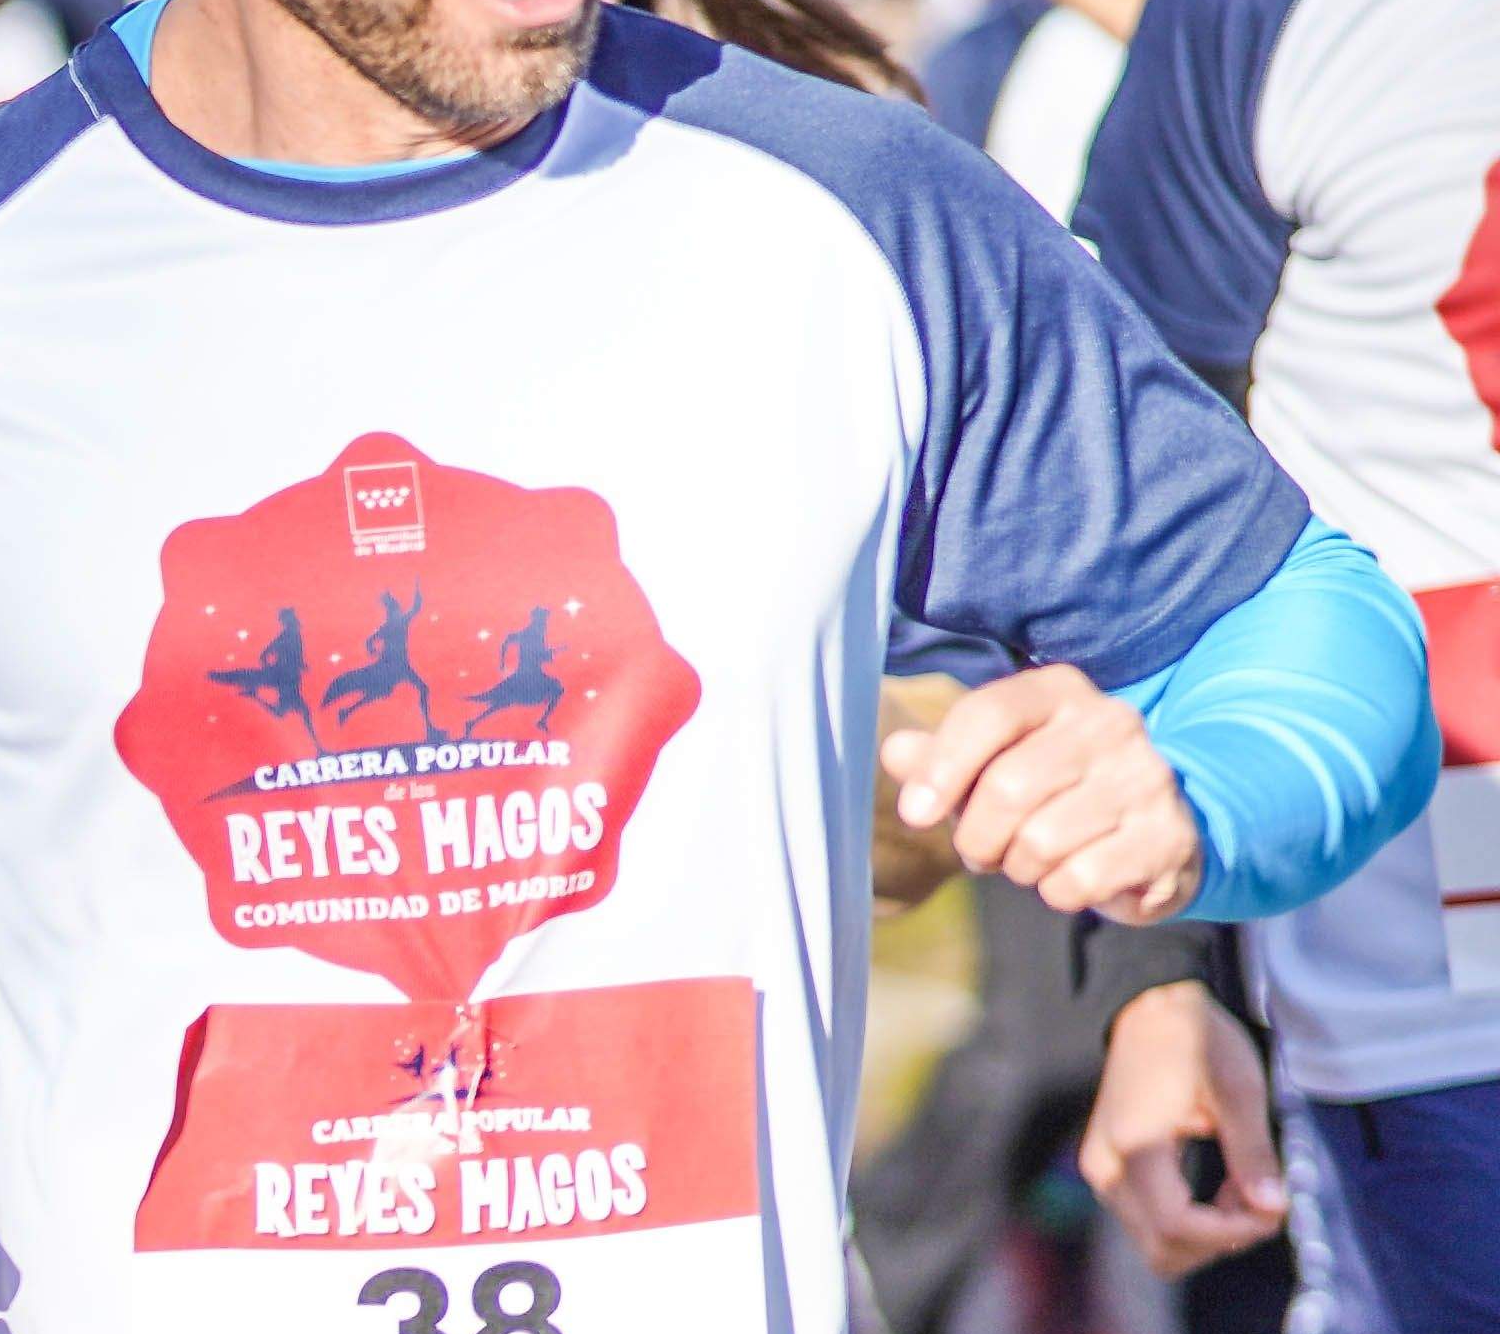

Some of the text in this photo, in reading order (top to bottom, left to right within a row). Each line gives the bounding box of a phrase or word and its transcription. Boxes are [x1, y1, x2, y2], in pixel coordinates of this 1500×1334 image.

[254, 741, 570, 790] CARRERA POPULAR
[384, 782, 436, 801] de los
[226, 782, 607, 884] REYES MAGOS
[234, 871, 595, 928] COMUNIDAD DE MADRID
[460, 1107, 591, 1133] POPULAR
[255, 1143, 647, 1237] REYES MAGOS
